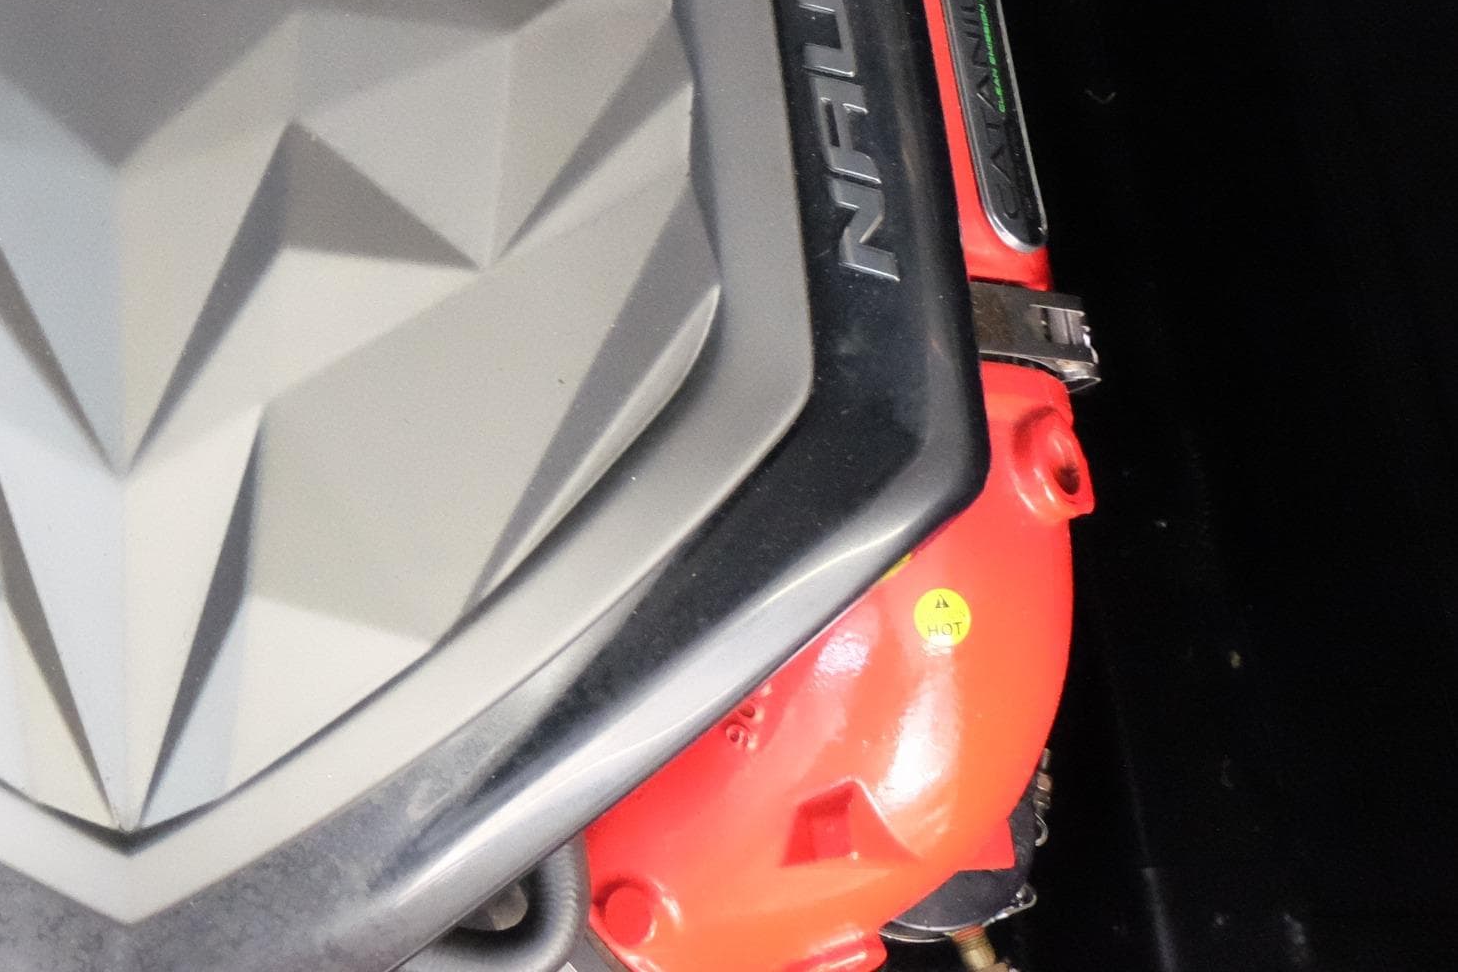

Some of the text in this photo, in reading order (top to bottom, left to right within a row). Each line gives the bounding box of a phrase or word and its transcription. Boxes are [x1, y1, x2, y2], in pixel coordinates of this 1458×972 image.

[978, 3, 999, 66] EMISSION
[991, 66, 1007, 114] CLEAN
[927, 621, 963, 637] HOT
